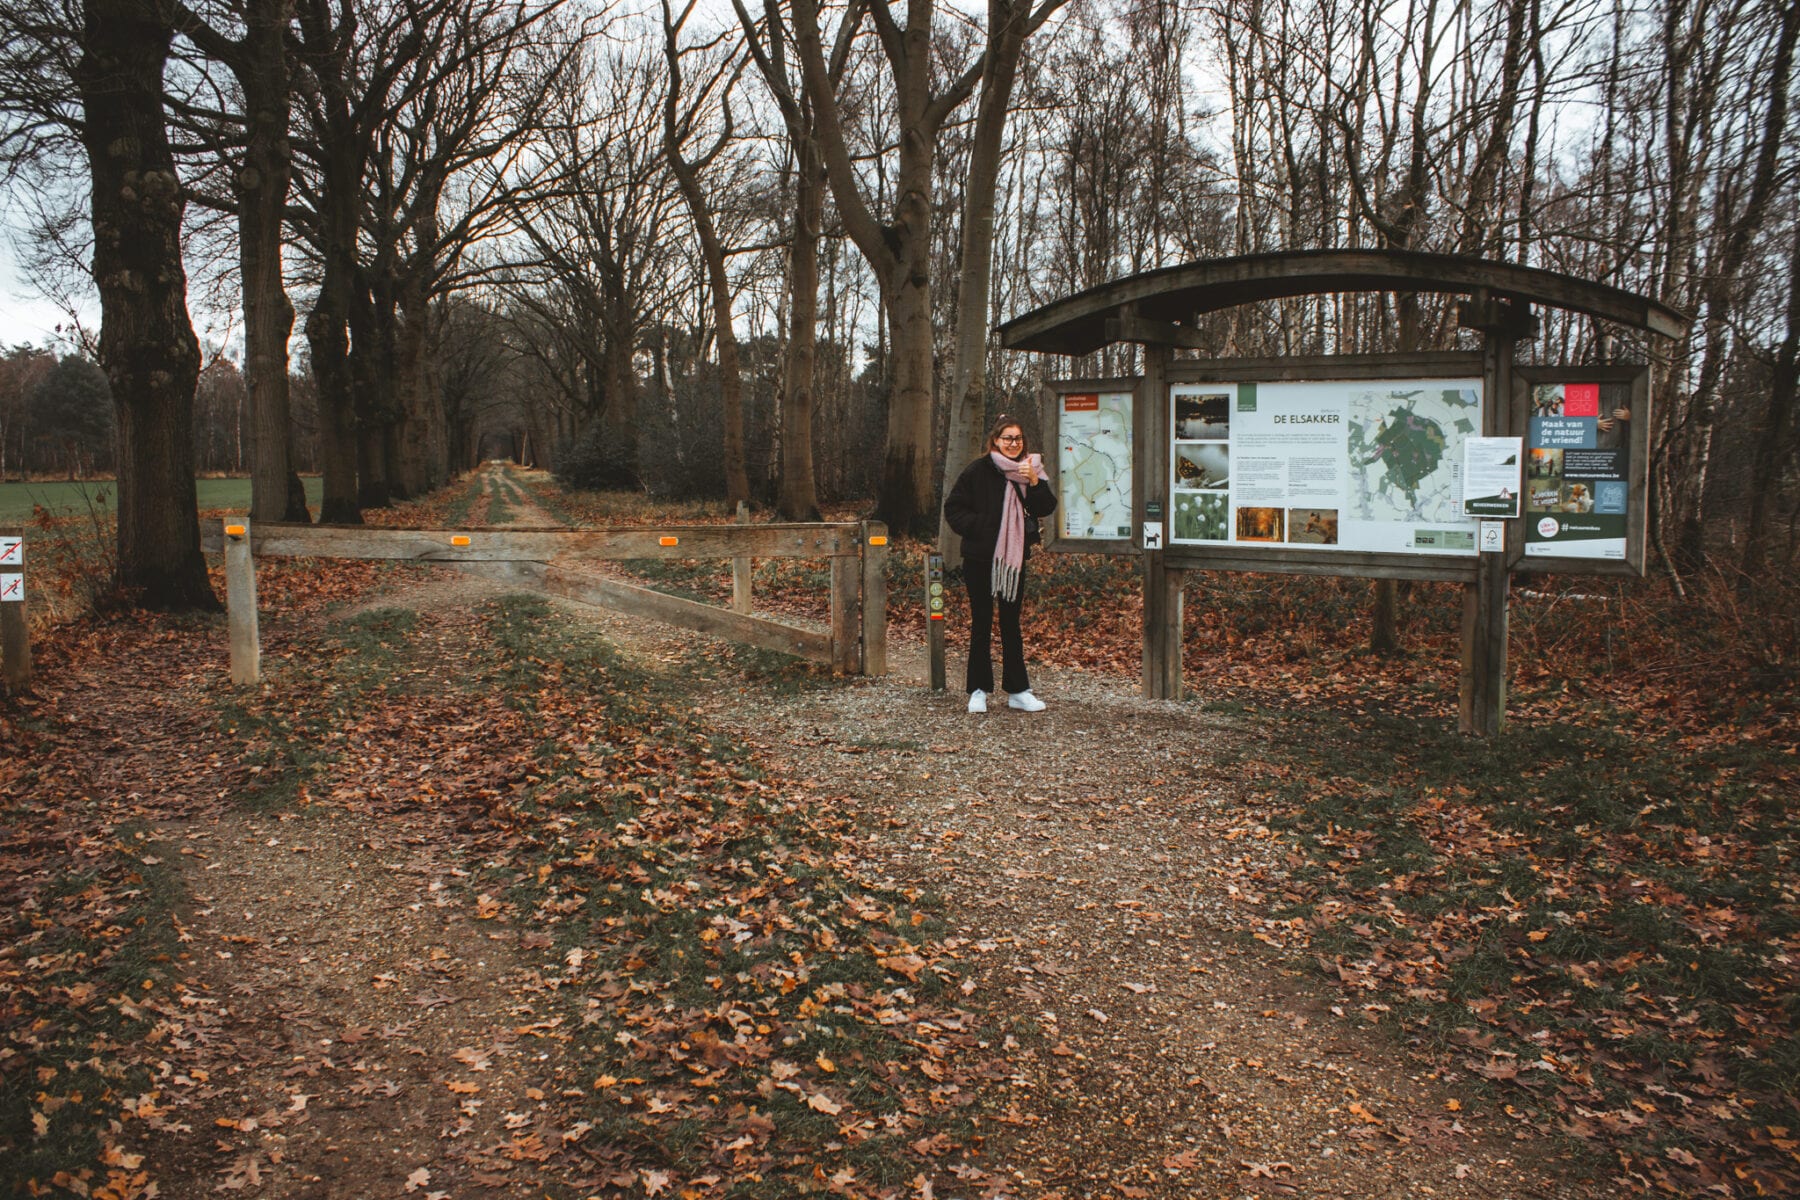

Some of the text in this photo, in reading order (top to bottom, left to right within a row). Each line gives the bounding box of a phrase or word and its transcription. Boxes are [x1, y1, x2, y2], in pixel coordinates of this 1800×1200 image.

[1274, 414, 1340, 424] DE ELSAKKER
[1540, 436, 1583, 446] je vriend!
